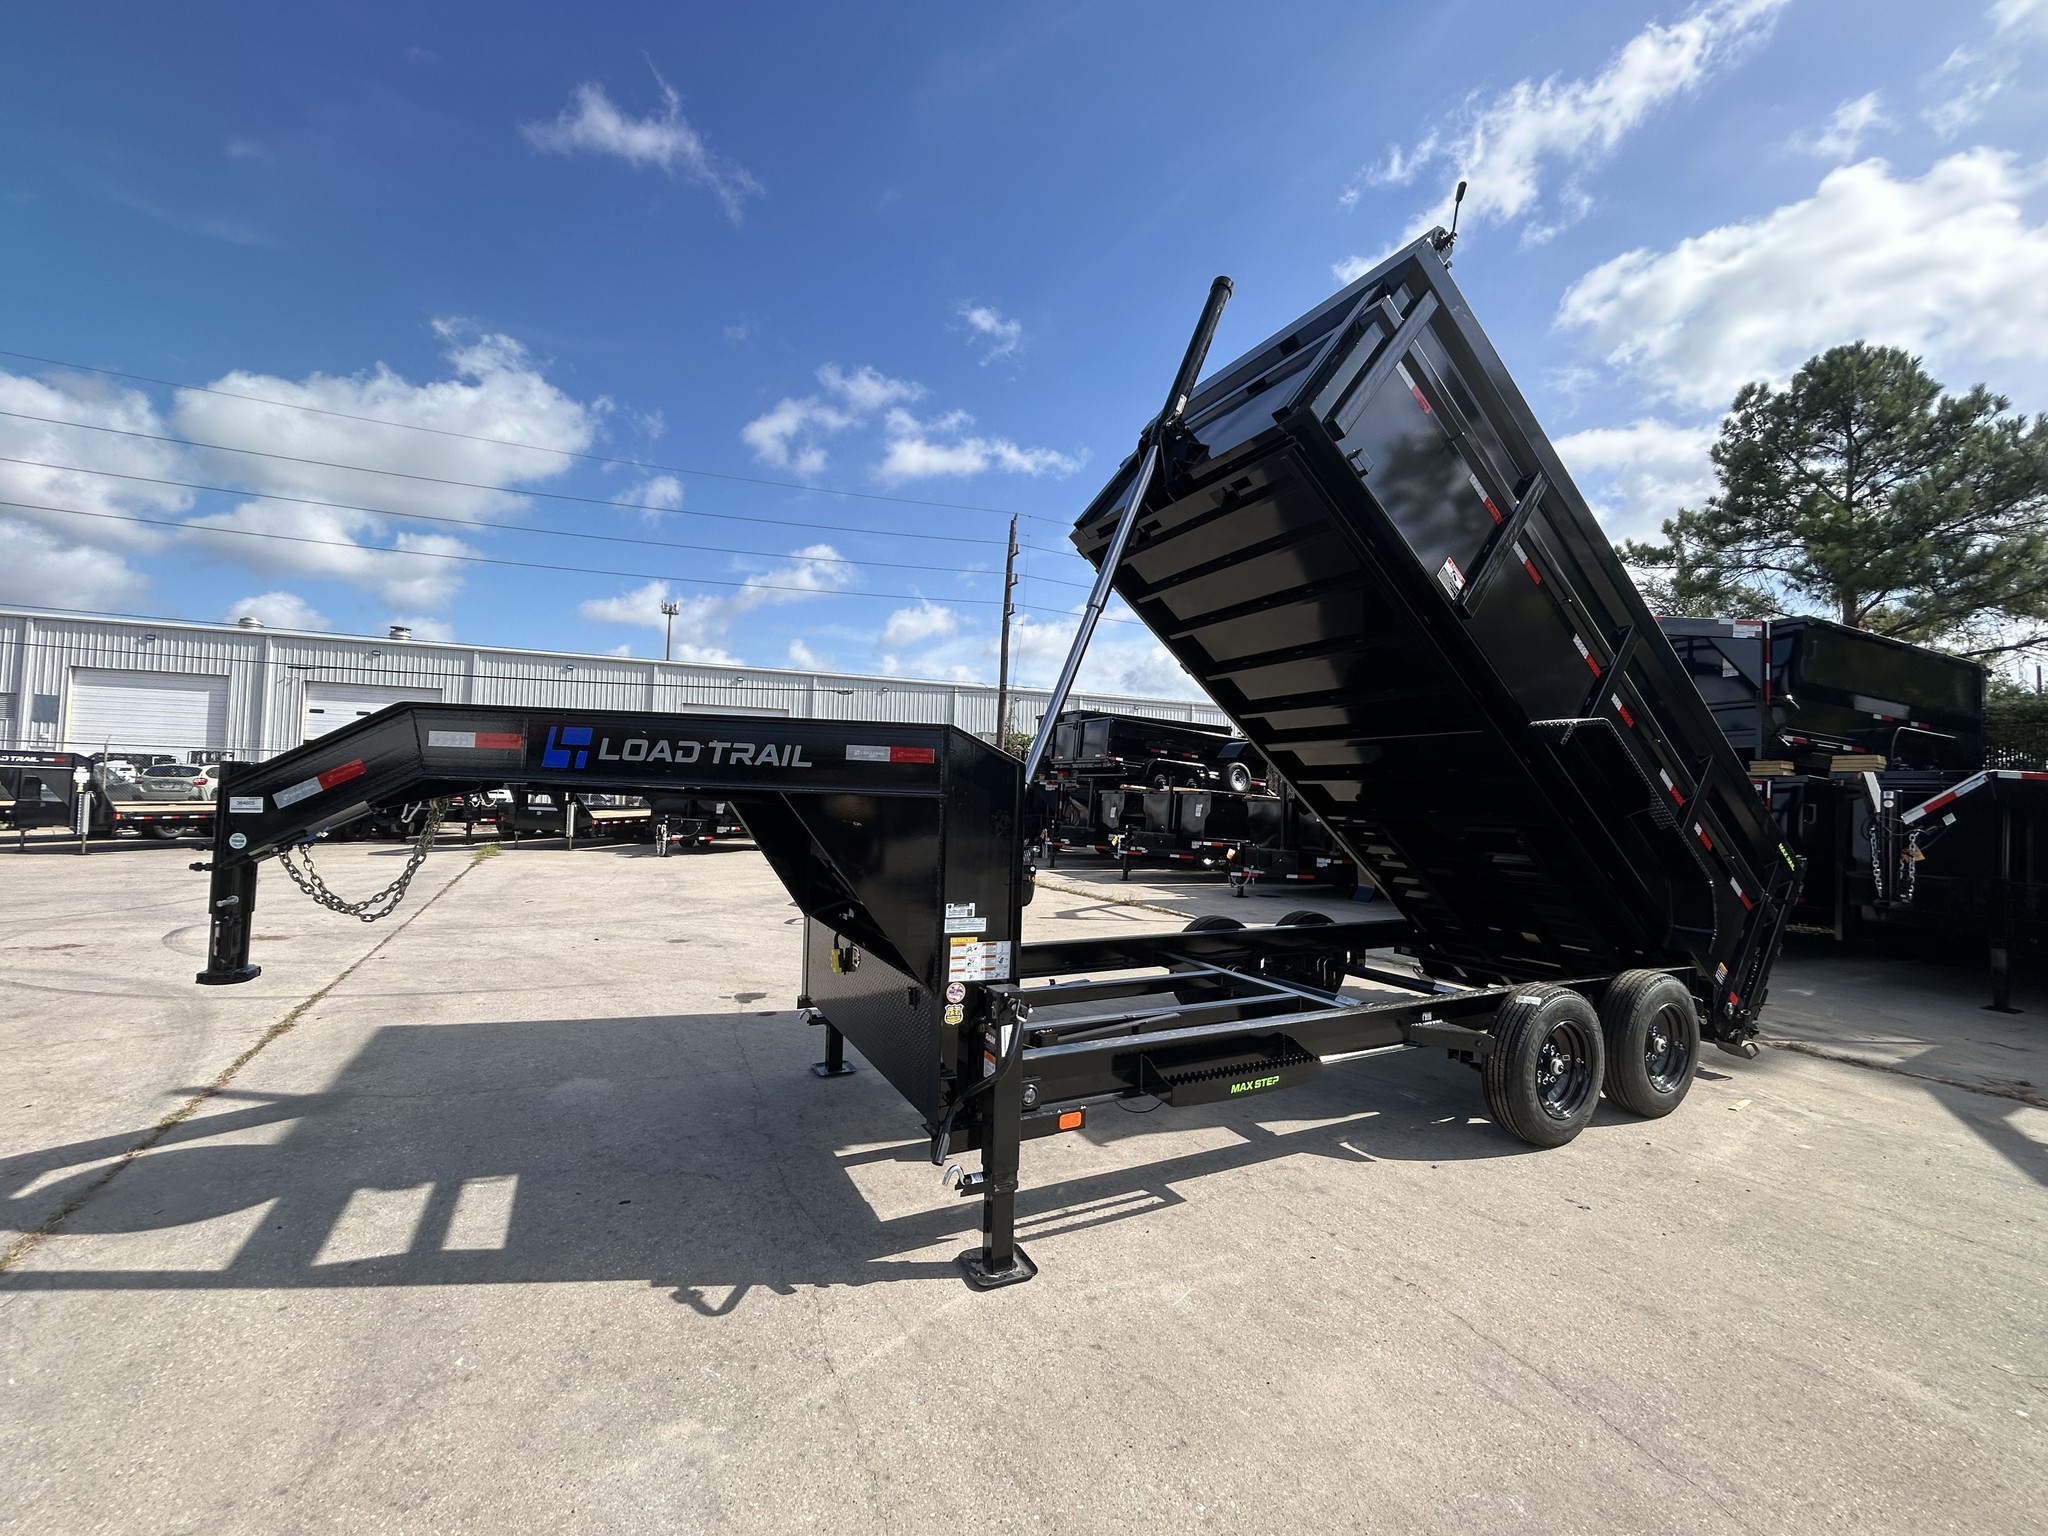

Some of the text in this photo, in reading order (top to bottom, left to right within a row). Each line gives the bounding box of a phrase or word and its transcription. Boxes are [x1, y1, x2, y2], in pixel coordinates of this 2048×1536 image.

[598, 737, 812, 768] LOAD TRAIL
[1230, 1075, 1280, 1094] MAX STEP
